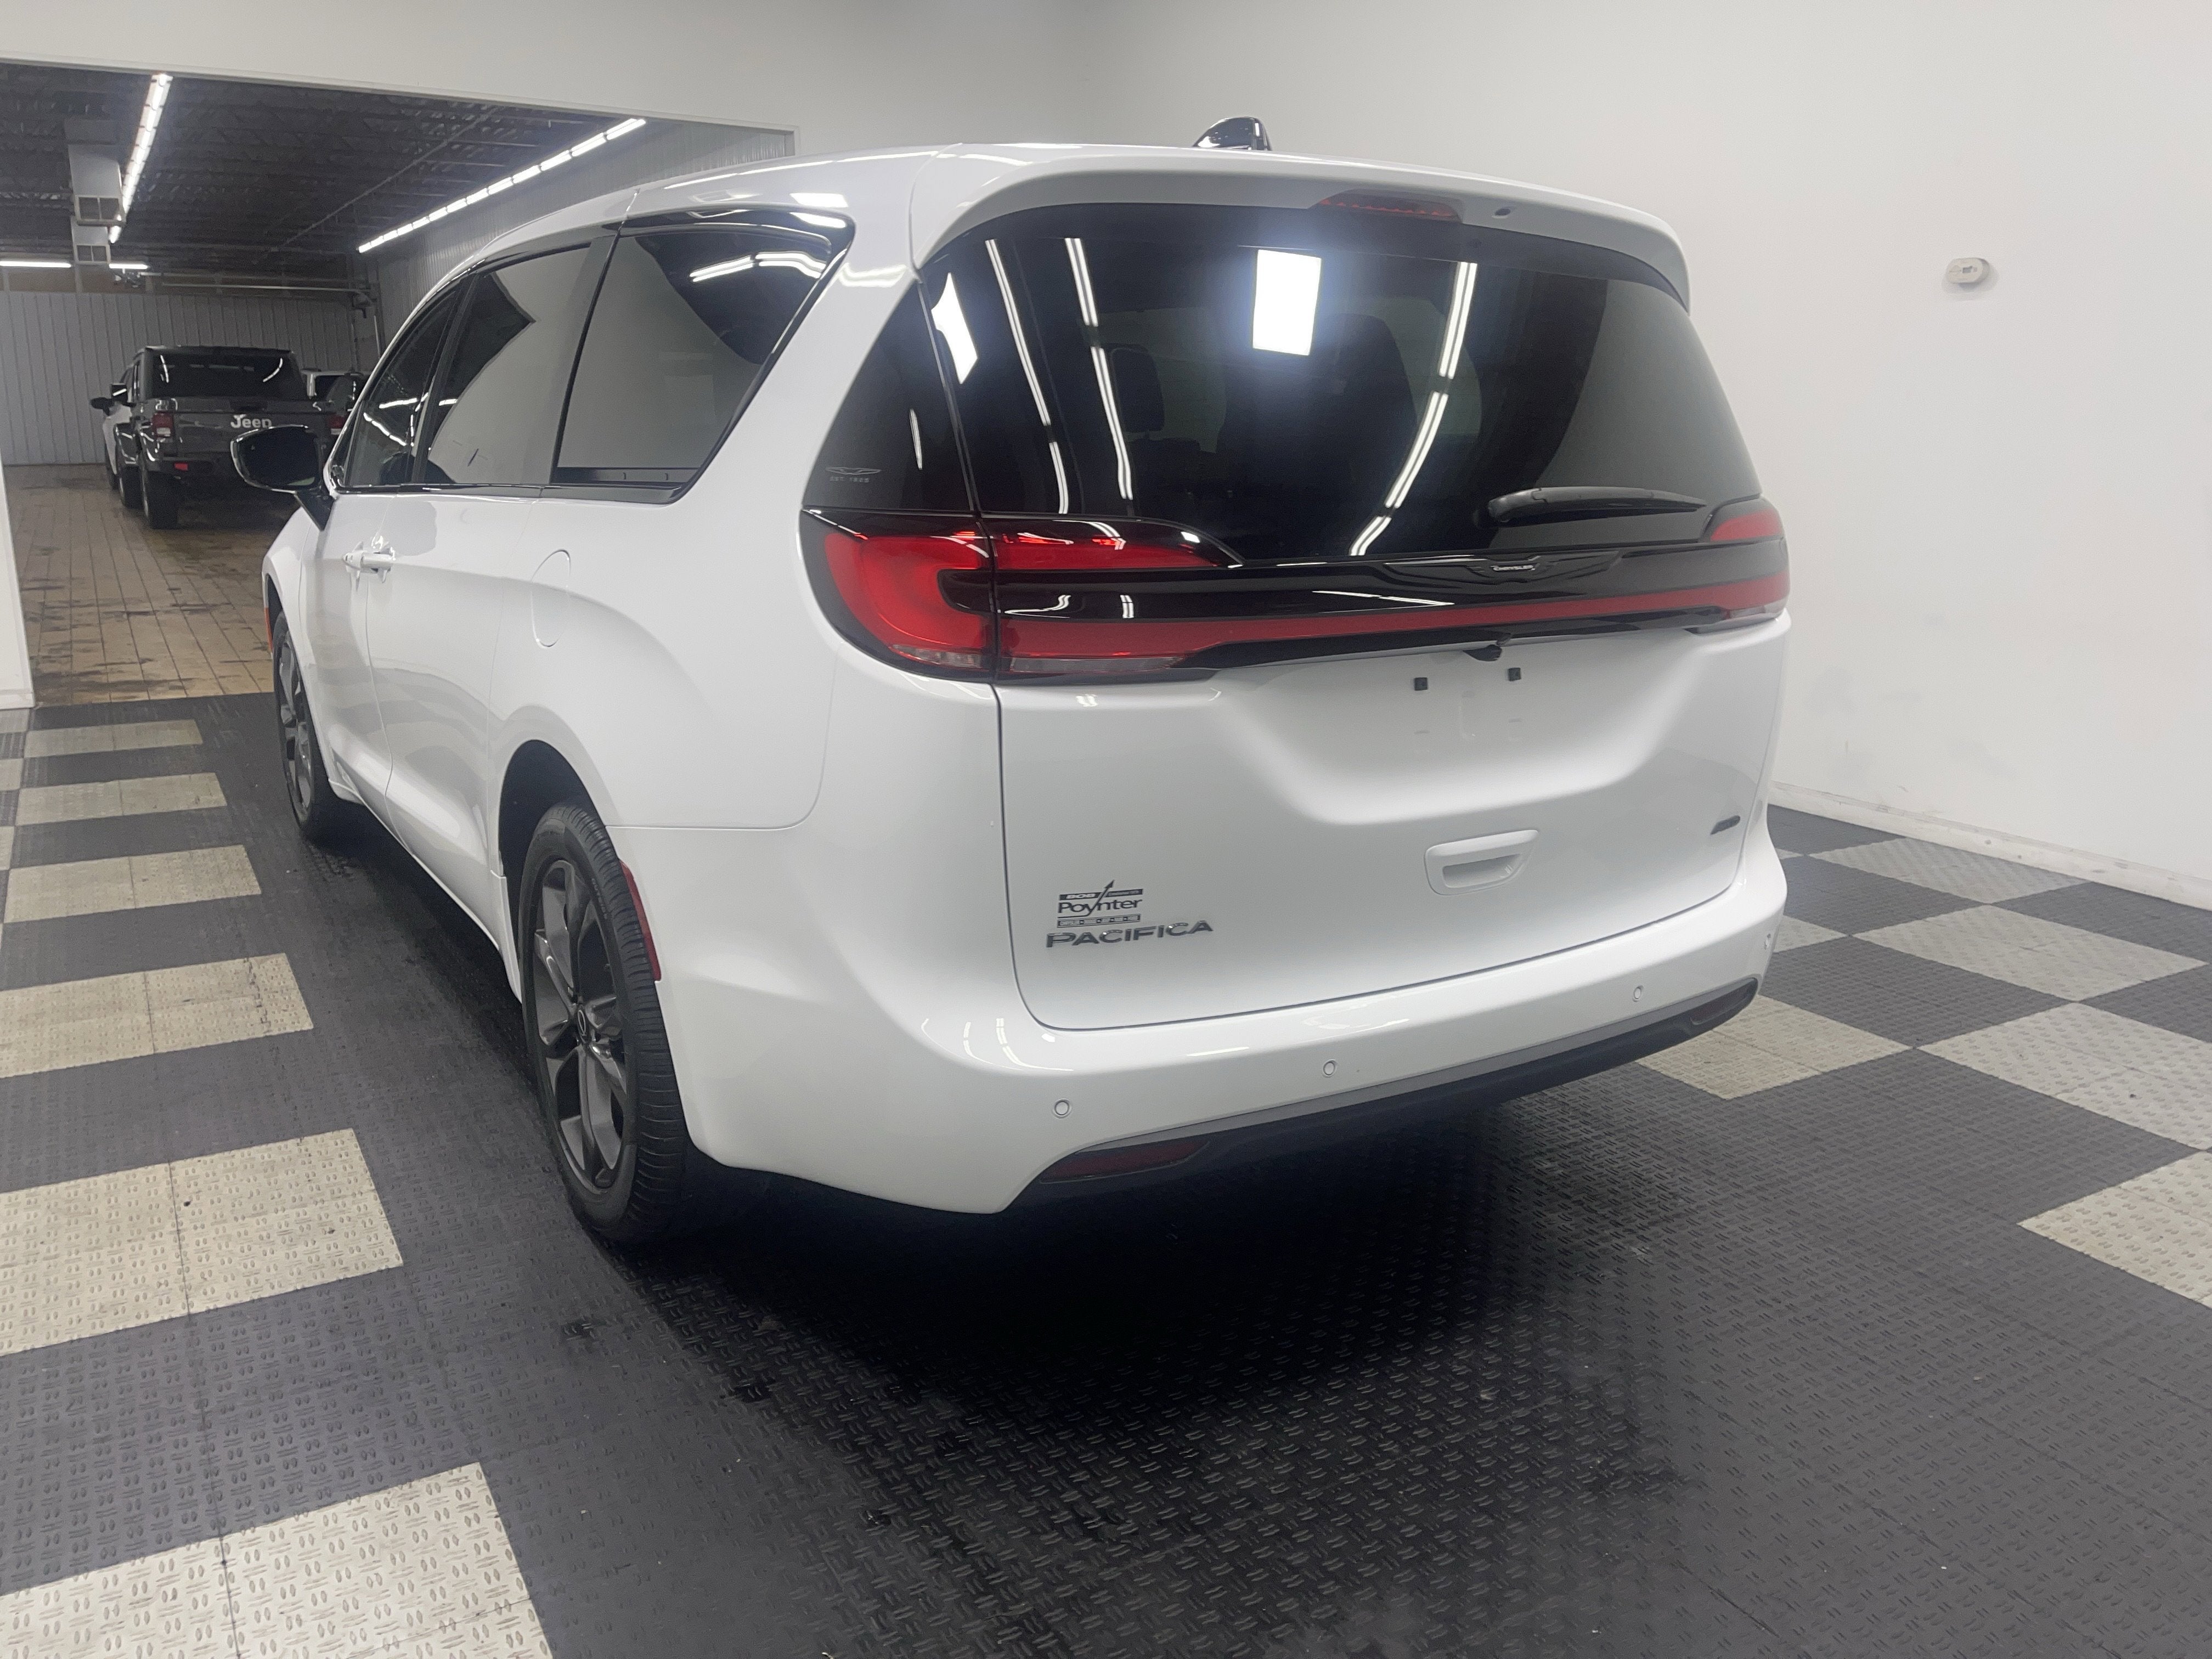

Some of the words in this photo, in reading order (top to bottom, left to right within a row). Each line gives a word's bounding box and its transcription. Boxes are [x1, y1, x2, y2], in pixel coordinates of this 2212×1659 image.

[230, 414, 272, 428] Jeep
[1058, 899, 1143, 915] Poynter
[1046, 919, 1214, 948] PACIFICA
